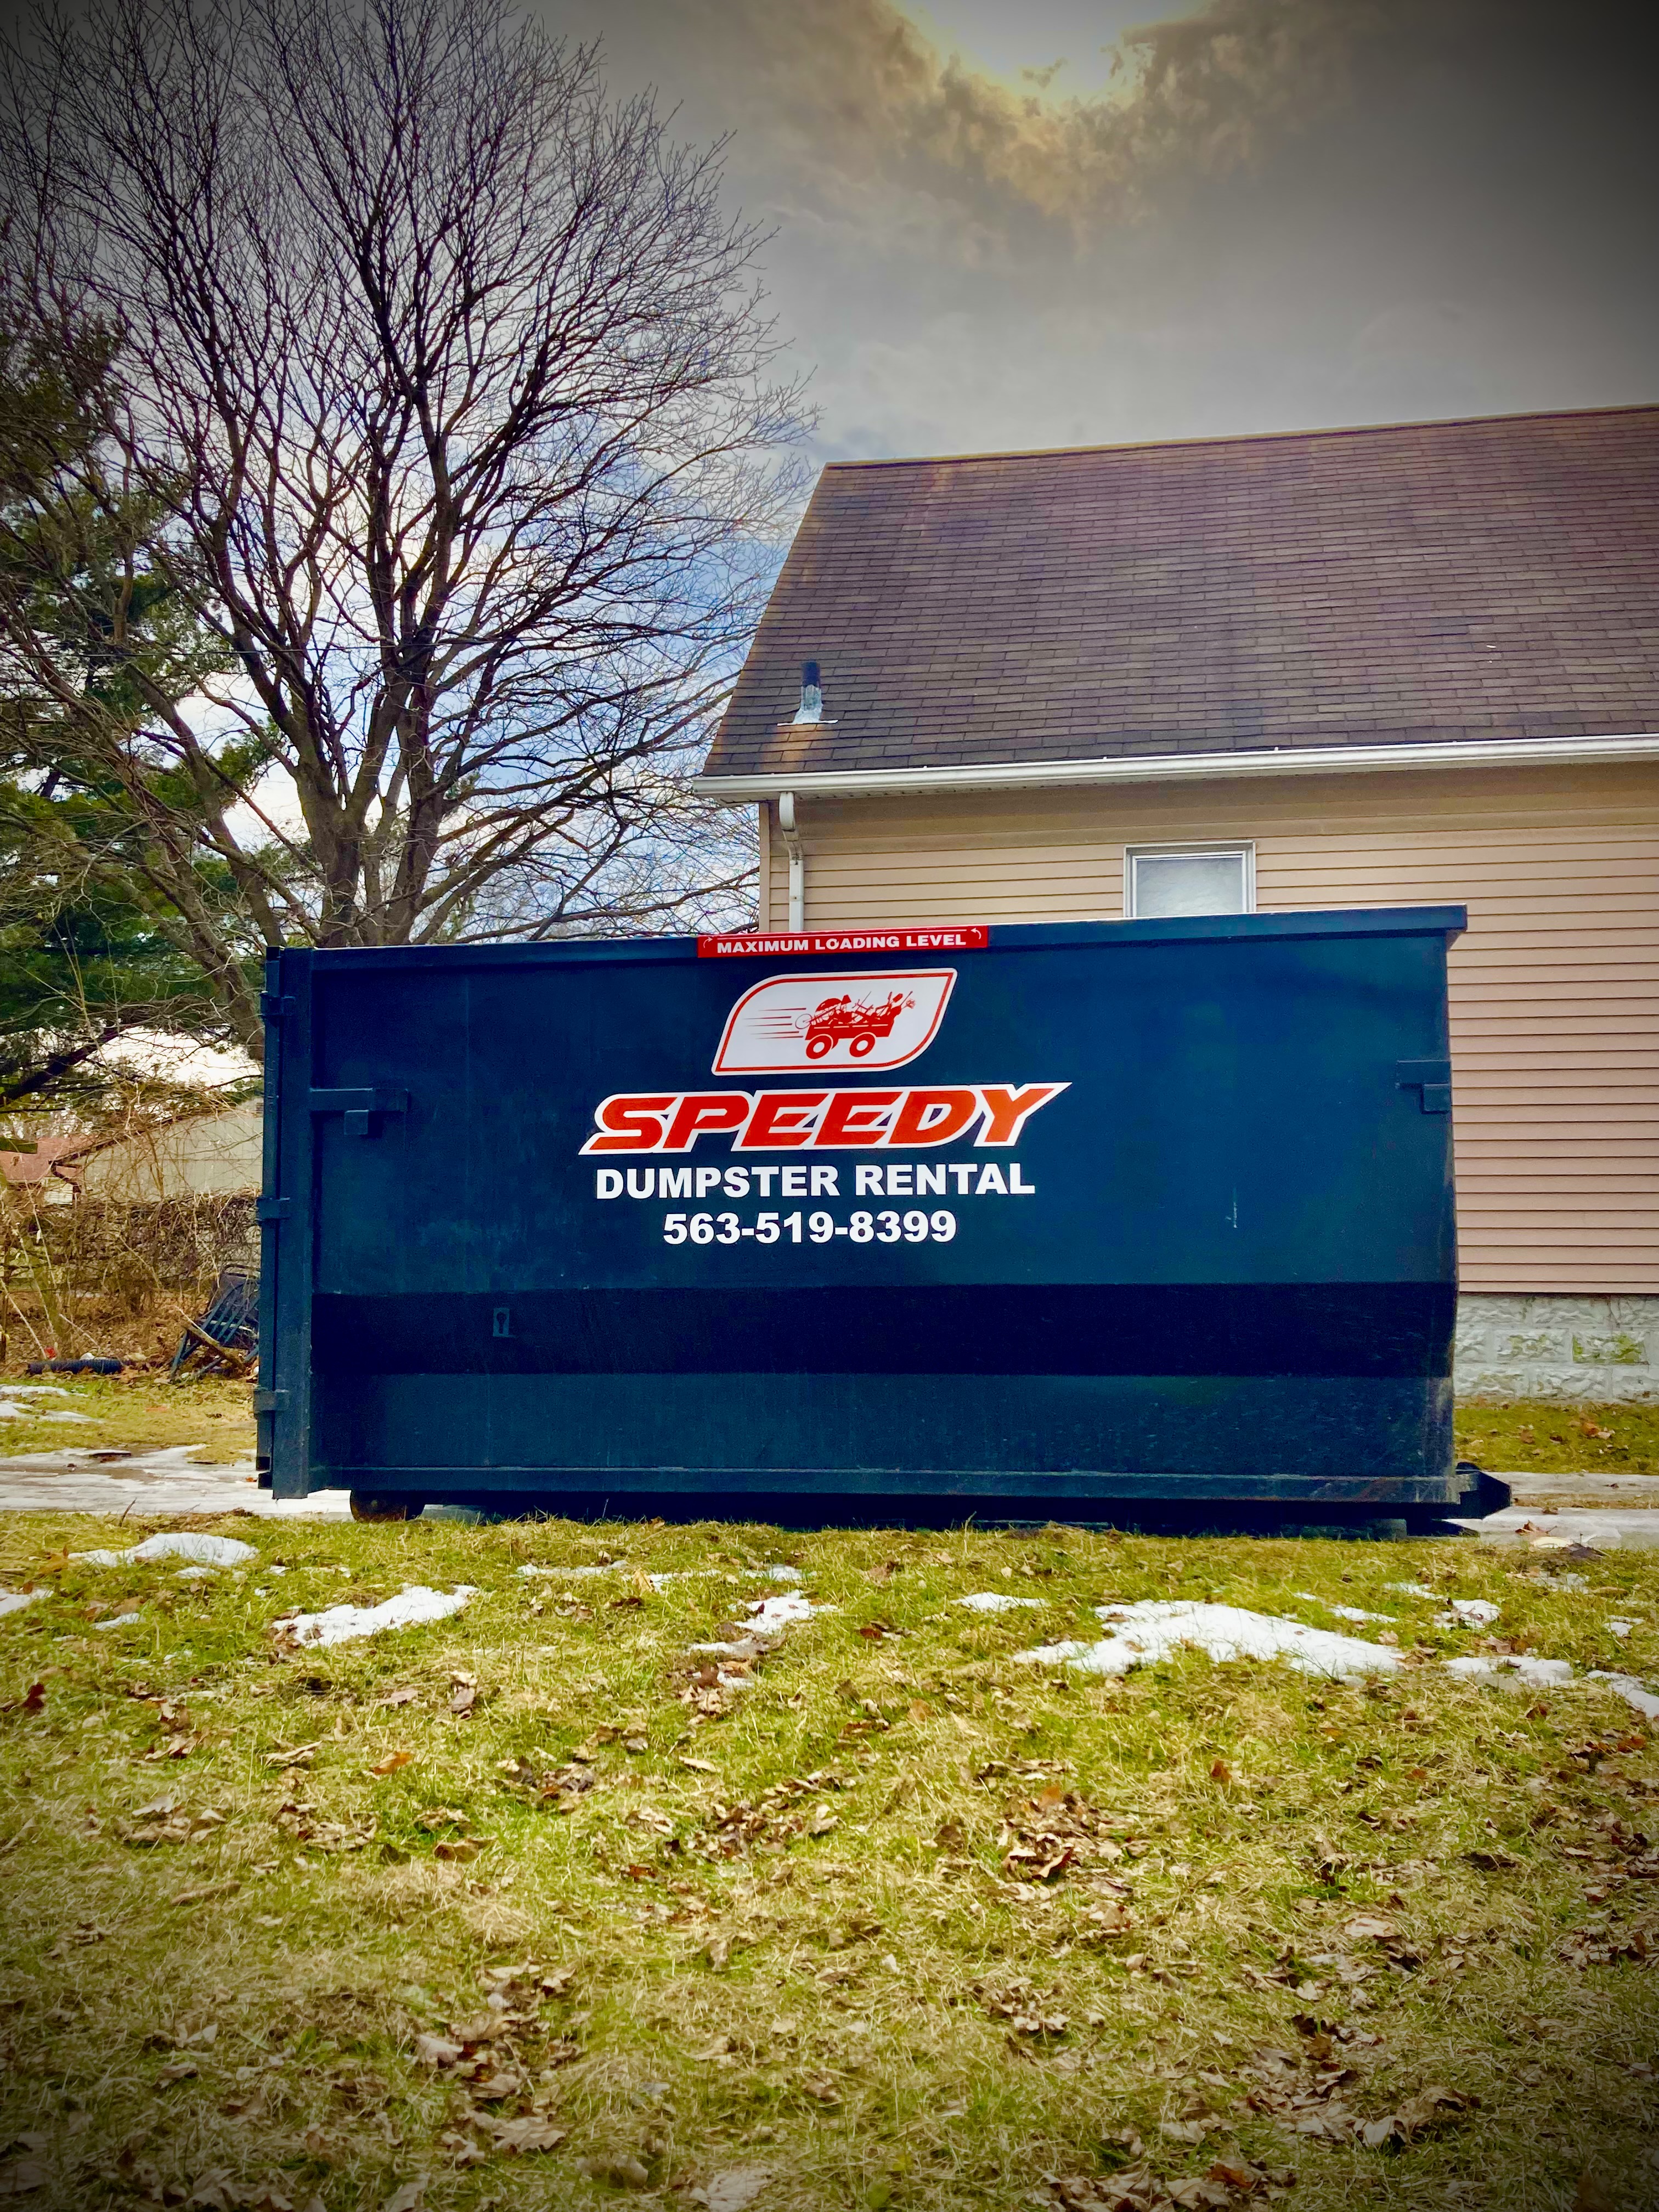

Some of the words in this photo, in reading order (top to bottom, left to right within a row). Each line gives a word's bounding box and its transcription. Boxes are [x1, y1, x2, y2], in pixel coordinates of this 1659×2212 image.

[716, 939, 809, 953] MAXIMUM
[815, 936, 900, 950] LOADING
[906, 934, 966, 947] LEVEL
[579, 1082, 1071, 1155] SPEEDY
[596, 1165, 839, 1200] DUMPSTER
[855, 1163, 1036, 1195] RENTAL
[663, 1210, 957, 1245] 563-519-8399
